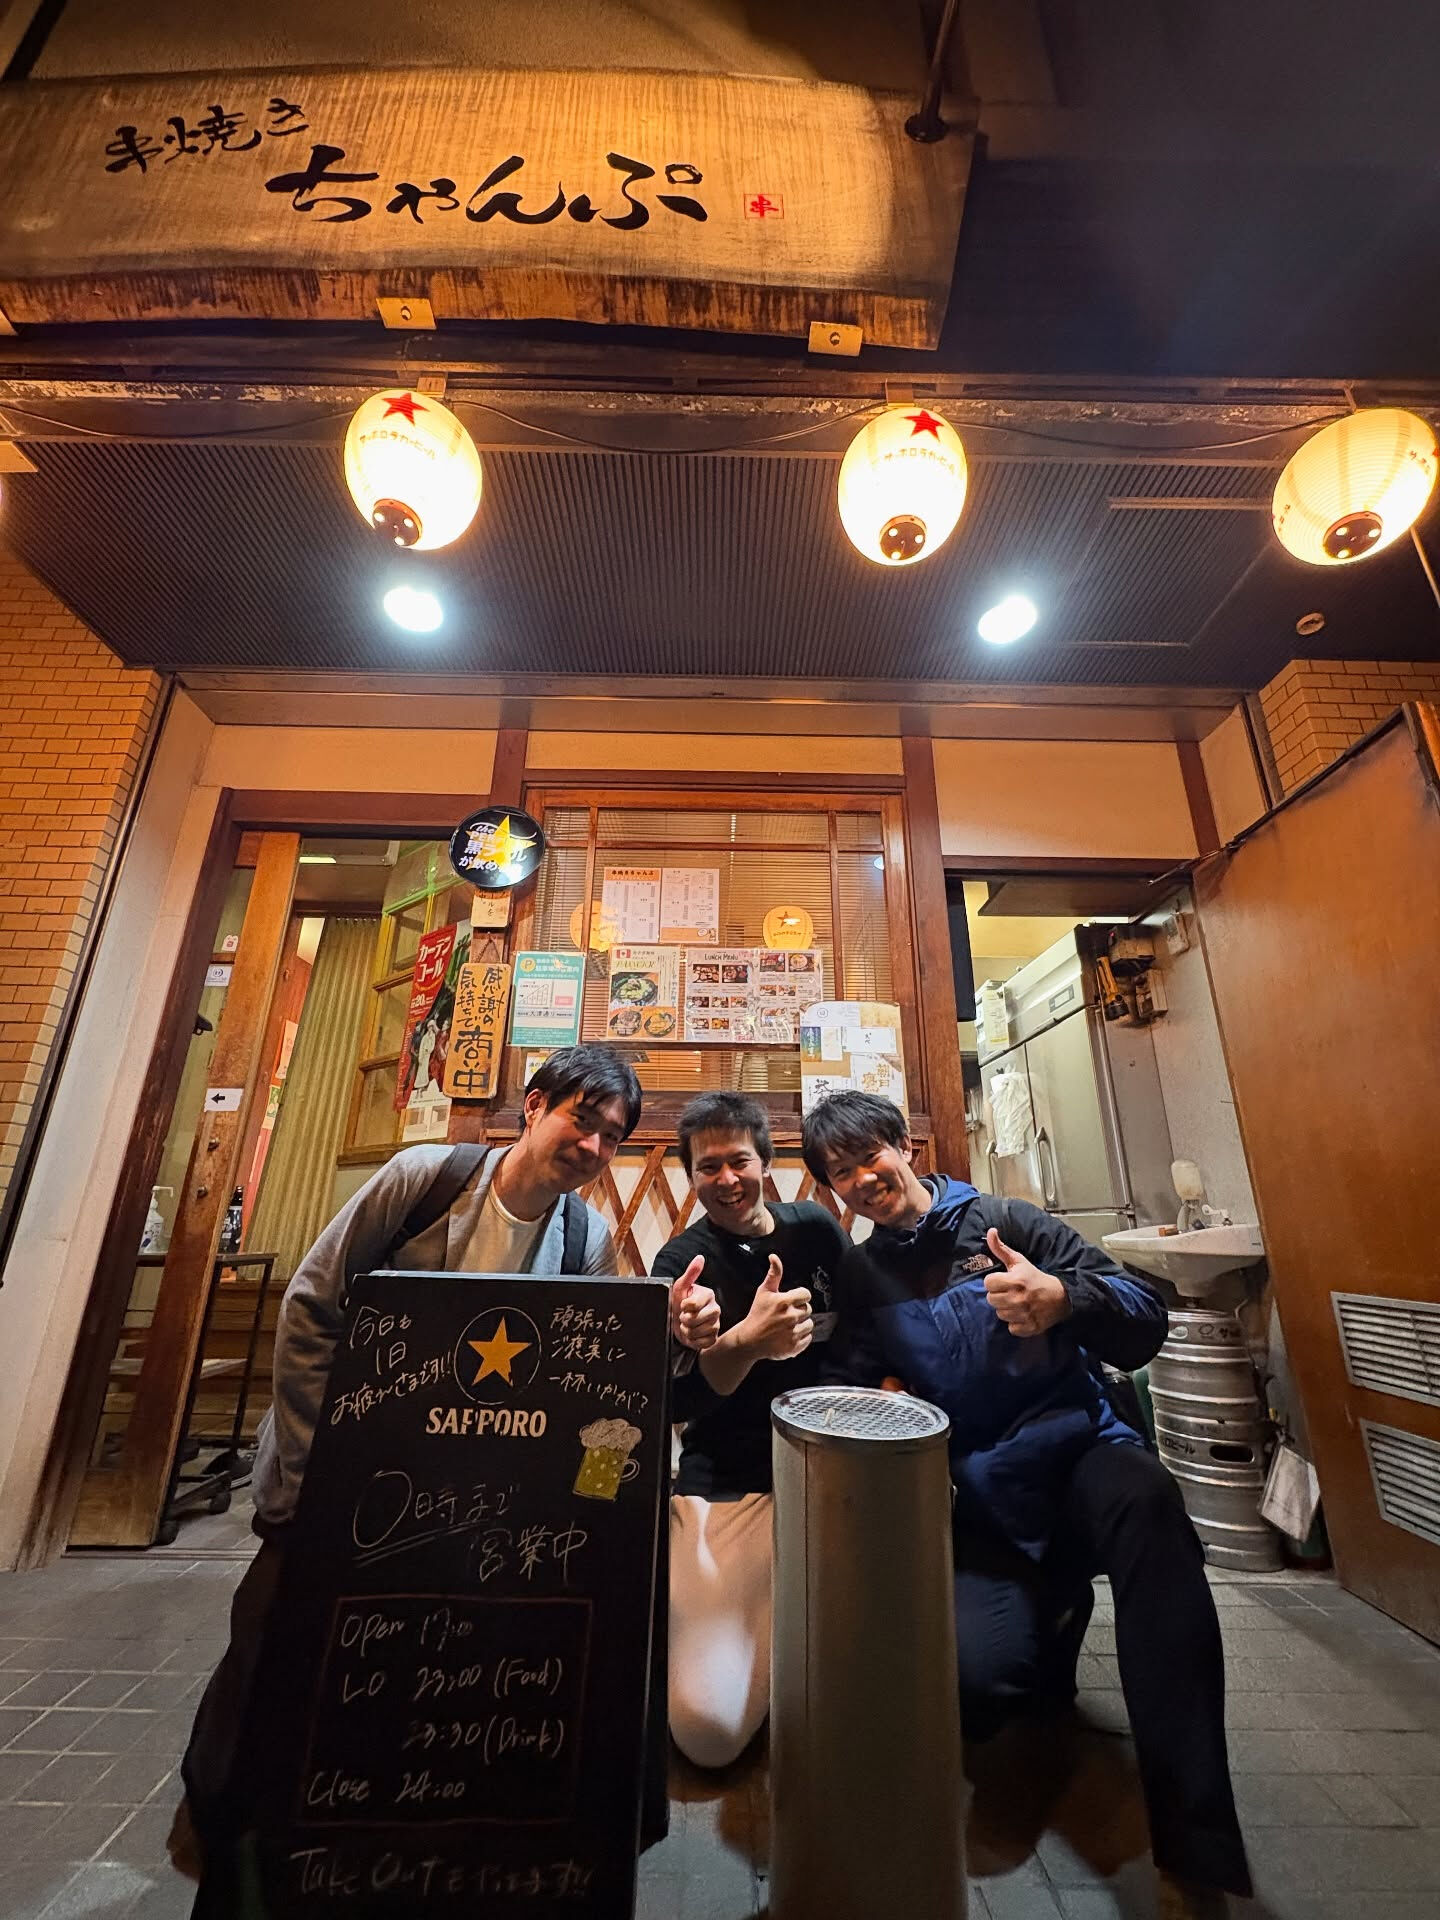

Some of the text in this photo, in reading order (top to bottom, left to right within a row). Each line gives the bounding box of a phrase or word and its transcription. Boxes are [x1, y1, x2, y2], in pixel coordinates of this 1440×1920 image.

[105, 97, 310, 174] 串焼き
[266, 145, 708, 230] ちゃんぷ
[747, 194, 779, 219] 串
[416, 957, 444, 982] コール
[457, 970, 479, 1027] 気持ちで
[477, 967, 504, 1025] 感謝の
[350, 1306, 412, 1349] 今日も
[551, 1306, 622, 1330] 頑張った
[551, 1335, 627, 1363] ご褒美に
[425, 1407, 547, 1438] SAPPORO
[470, 1521, 588, 1586] 営業中
[342, 1670, 385, 1704] LO
[493, 1656, 563, 1700] (Food)
[483, 1714, 565, 1765] (Drink)
[307, 1769, 371, 1807] Close
